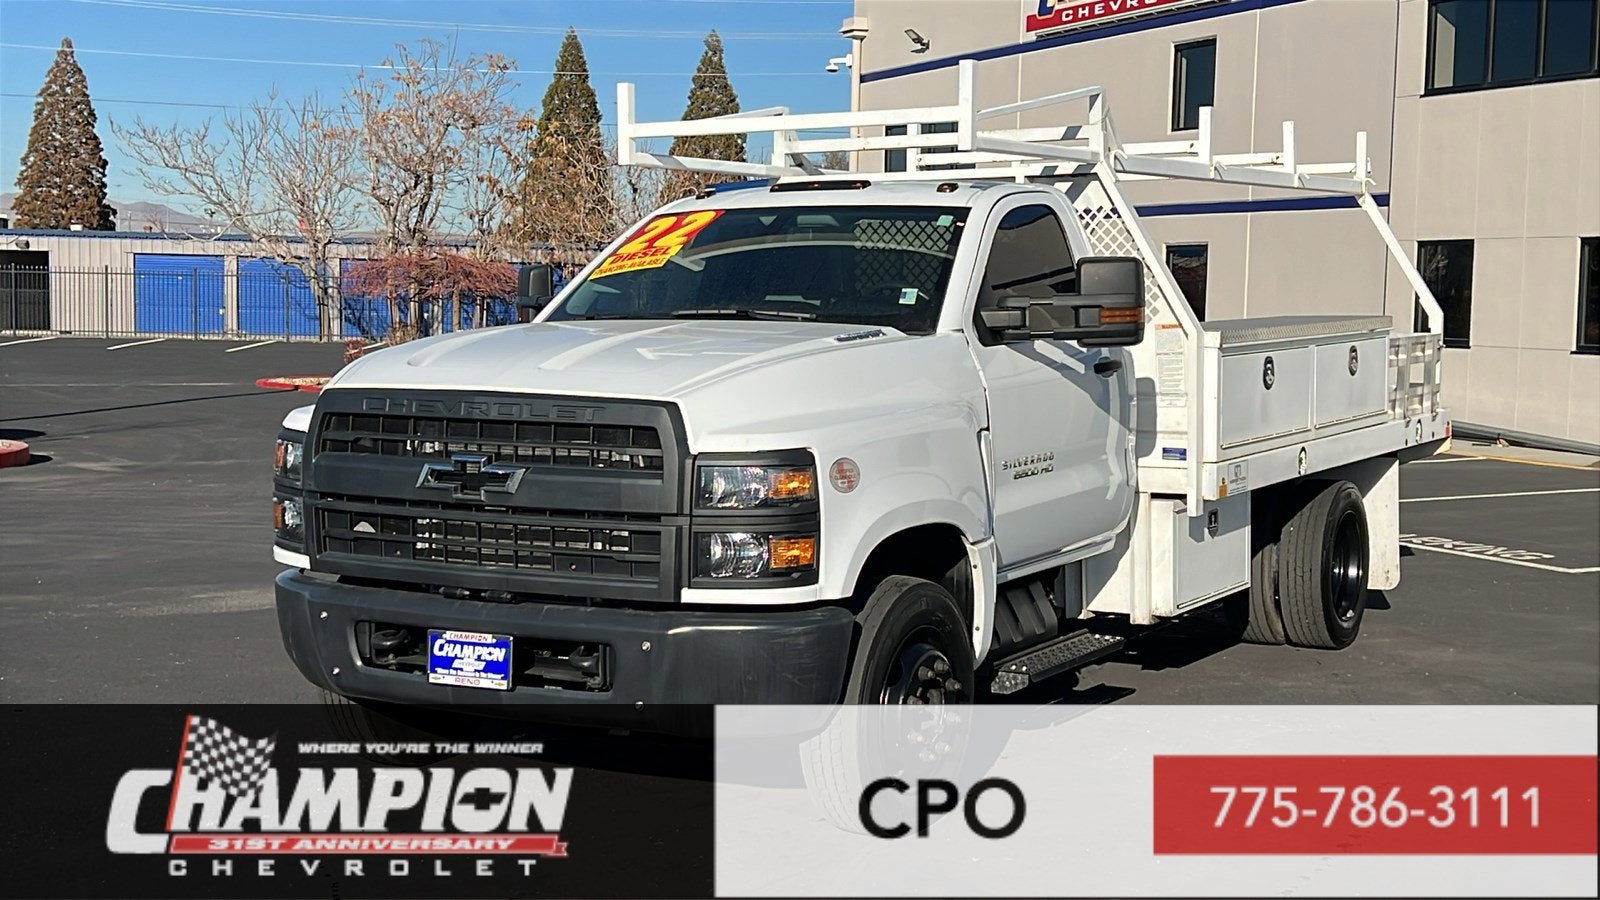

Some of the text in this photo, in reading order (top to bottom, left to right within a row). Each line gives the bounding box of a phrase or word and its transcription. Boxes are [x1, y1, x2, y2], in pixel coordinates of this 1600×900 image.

[615, 211, 717, 254] 22
[608, 247, 671, 265] DIESEL
[363, 397, 605, 421] CHEVROLET
[1002, 452, 1054, 470] SILVERADO
[449, 632, 489, 642] CHAMPION
[433, 639, 506, 662] CHAMPION
[454, 677, 481, 686] RENO
